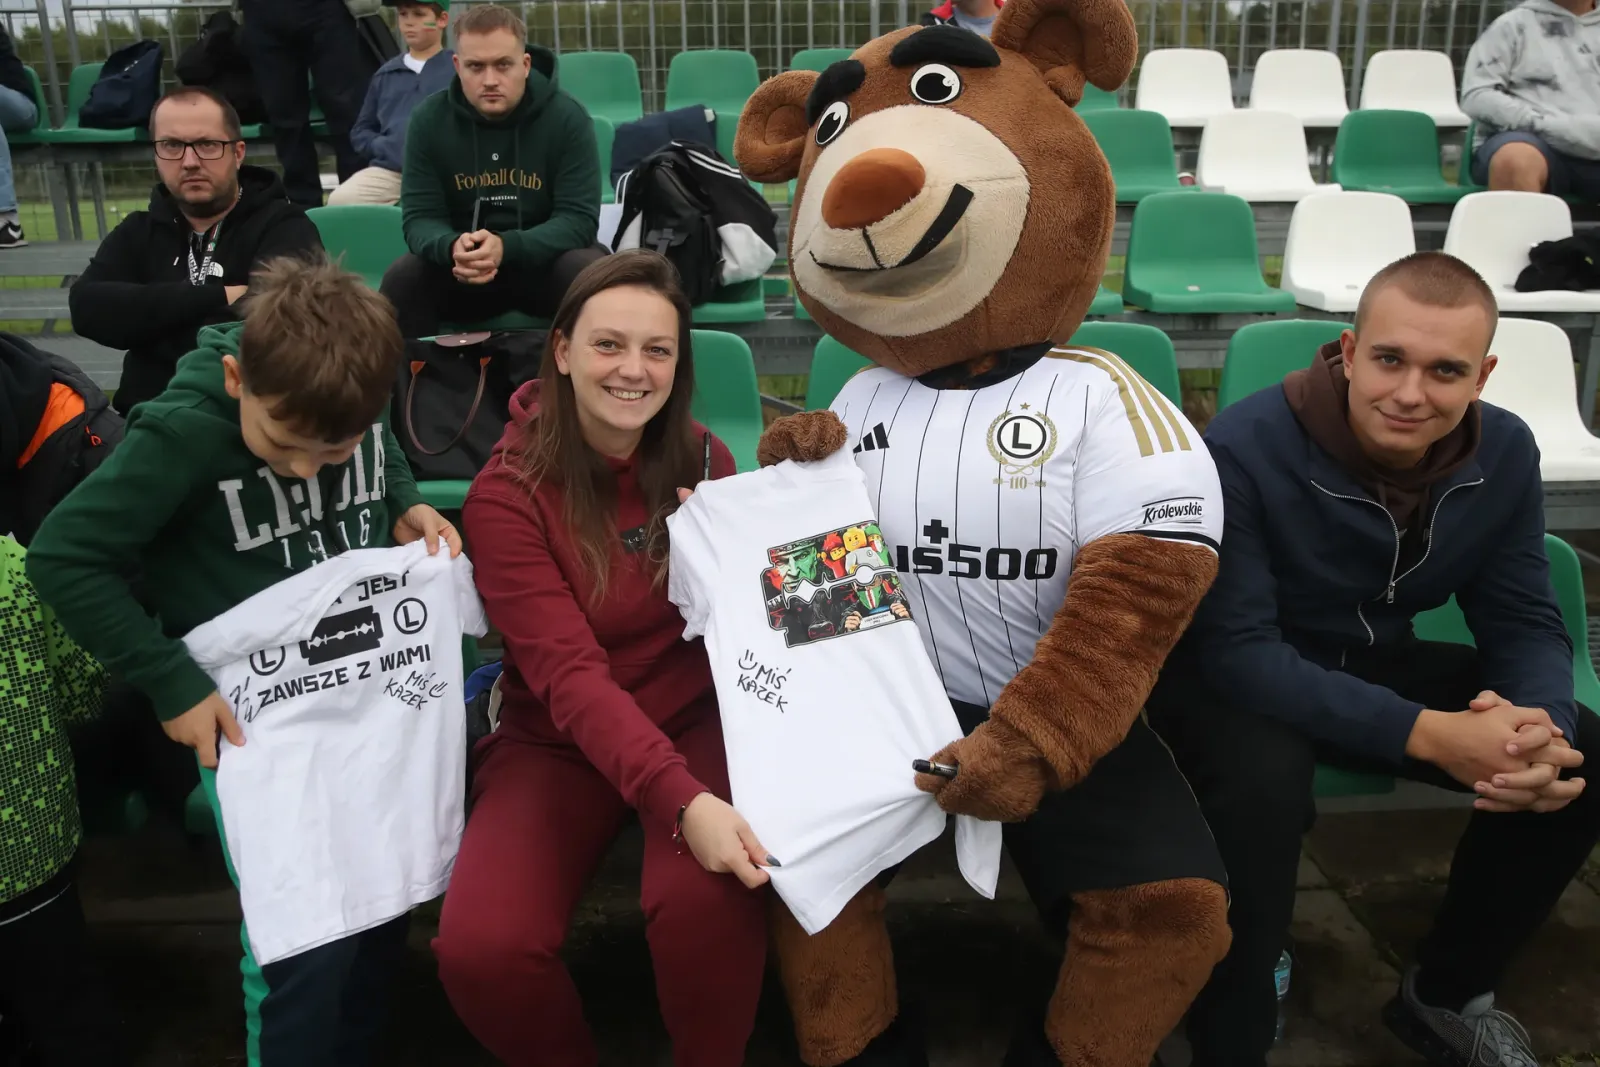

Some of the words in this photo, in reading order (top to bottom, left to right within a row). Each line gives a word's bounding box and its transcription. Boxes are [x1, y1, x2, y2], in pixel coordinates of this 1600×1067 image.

[1143, 502, 1203, 524] Królewskie
[257, 667, 350, 708] ZAWSZE
[356, 661, 371, 680] Z
[379, 644, 431, 672] WAMI
